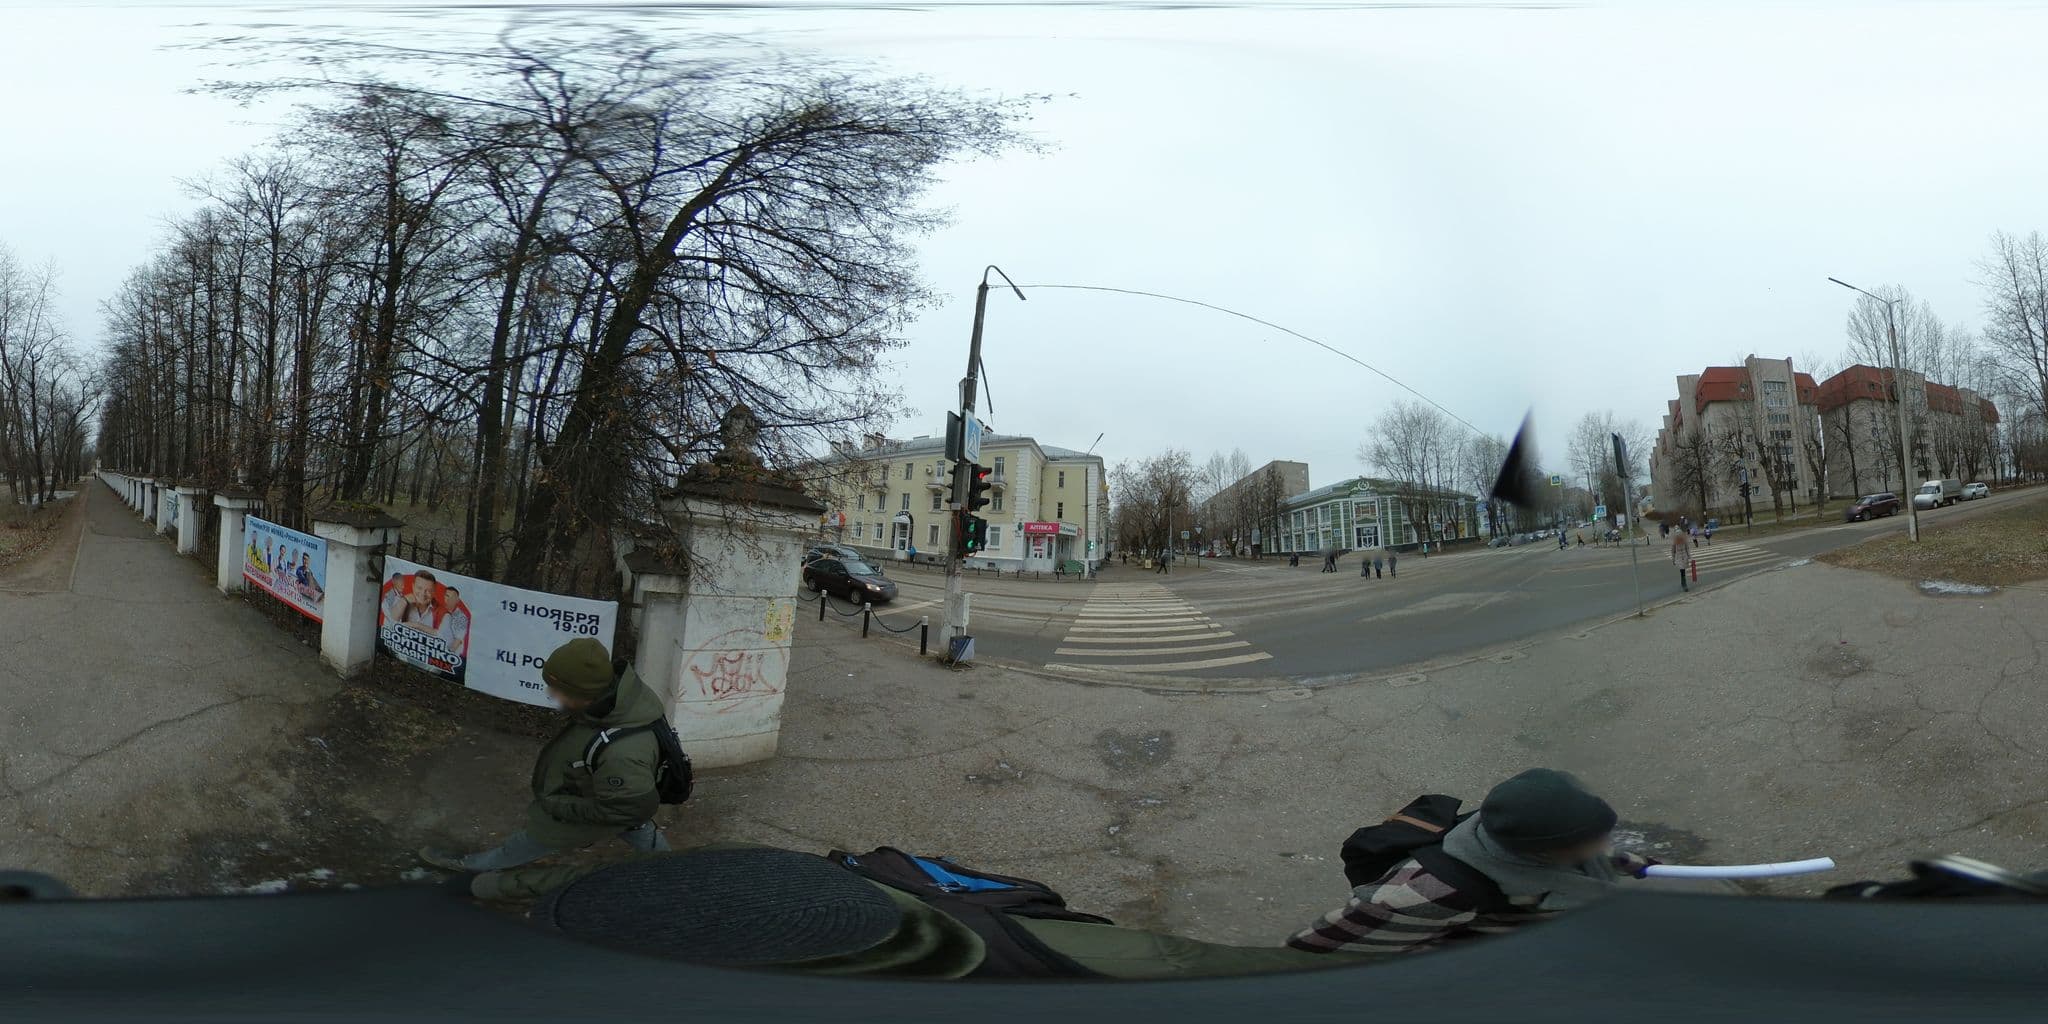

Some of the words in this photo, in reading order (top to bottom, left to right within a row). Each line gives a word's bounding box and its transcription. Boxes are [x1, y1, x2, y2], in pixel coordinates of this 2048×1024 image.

[501, 600, 518, 613] 19
[523, 604, 600, 625] НОЯБРЯ
[394, 624, 445, 650] СЕРГЕЙ
[553, 621, 599, 635] 19:00
[383, 630, 460, 665] ВОЙТЕНКО
[496, 649, 517, 666] КЦ
[522, 655, 545, 669] РО
[519, 679, 544, 691] тел:
